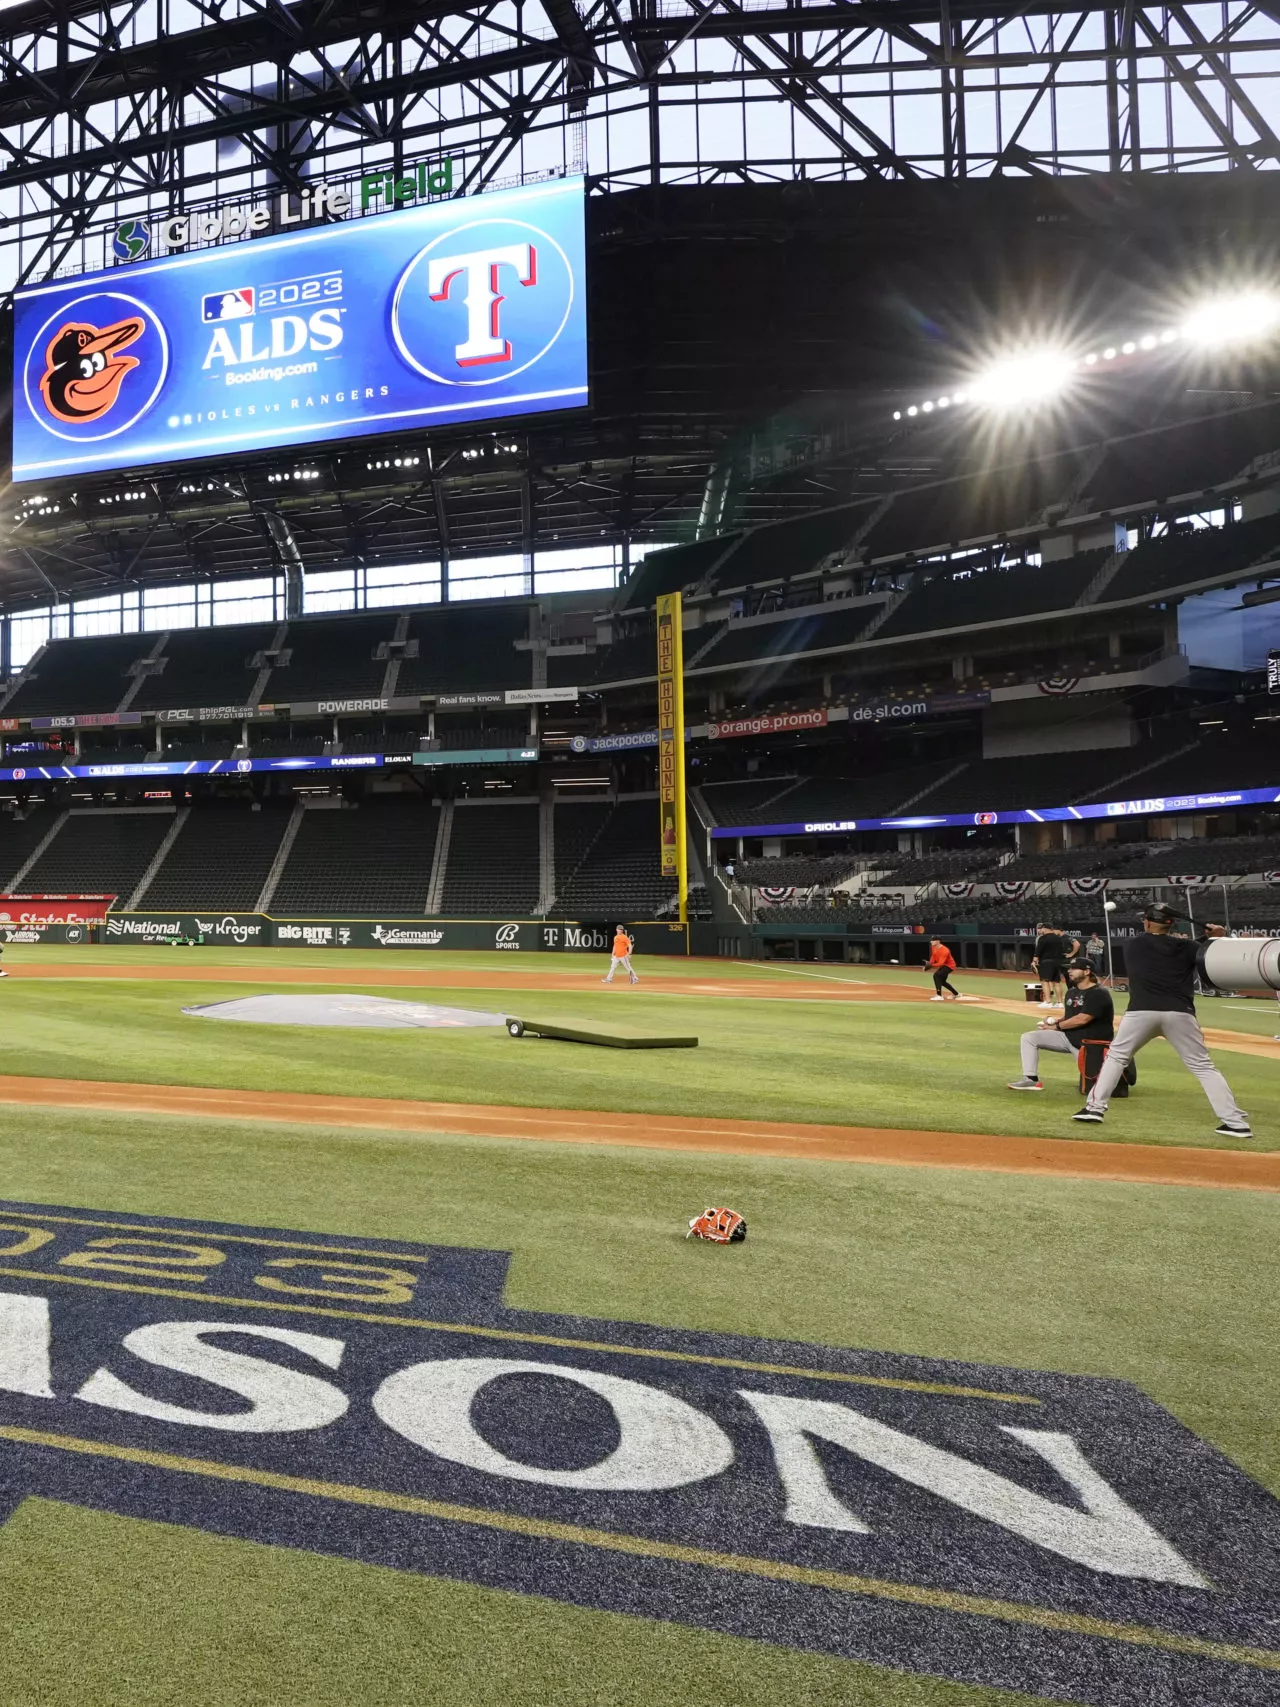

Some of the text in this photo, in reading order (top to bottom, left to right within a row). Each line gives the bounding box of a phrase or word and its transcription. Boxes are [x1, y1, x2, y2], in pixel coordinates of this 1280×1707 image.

[162, 157, 453, 249] Globe Life Field
[259, 277, 343, 307] 2023
[429, 243, 537, 368] T
[201, 308, 344, 370] ALDS
[225, 362, 318, 385] Booking.com
[291, 385, 389, 409] RANGERS
[1267, 658, 1278, 688] TRULY
[318, 699, 389, 712] POWERADE
[459, 695, 476, 703] fans
[477, 694, 502, 702] know.
[51, 714, 119, 727] 105.3 THE FAN
[167, 709, 194, 719] PGL
[721, 712, 822, 733] orange.promo
[1127, 799, 1165, 813] ALDS
[804, 821, 856, 832] ORIOLES
[68, 930, 80, 938] ADT
[215, 917, 261, 943] Kroger
[391, 928, 443, 939] Germania
